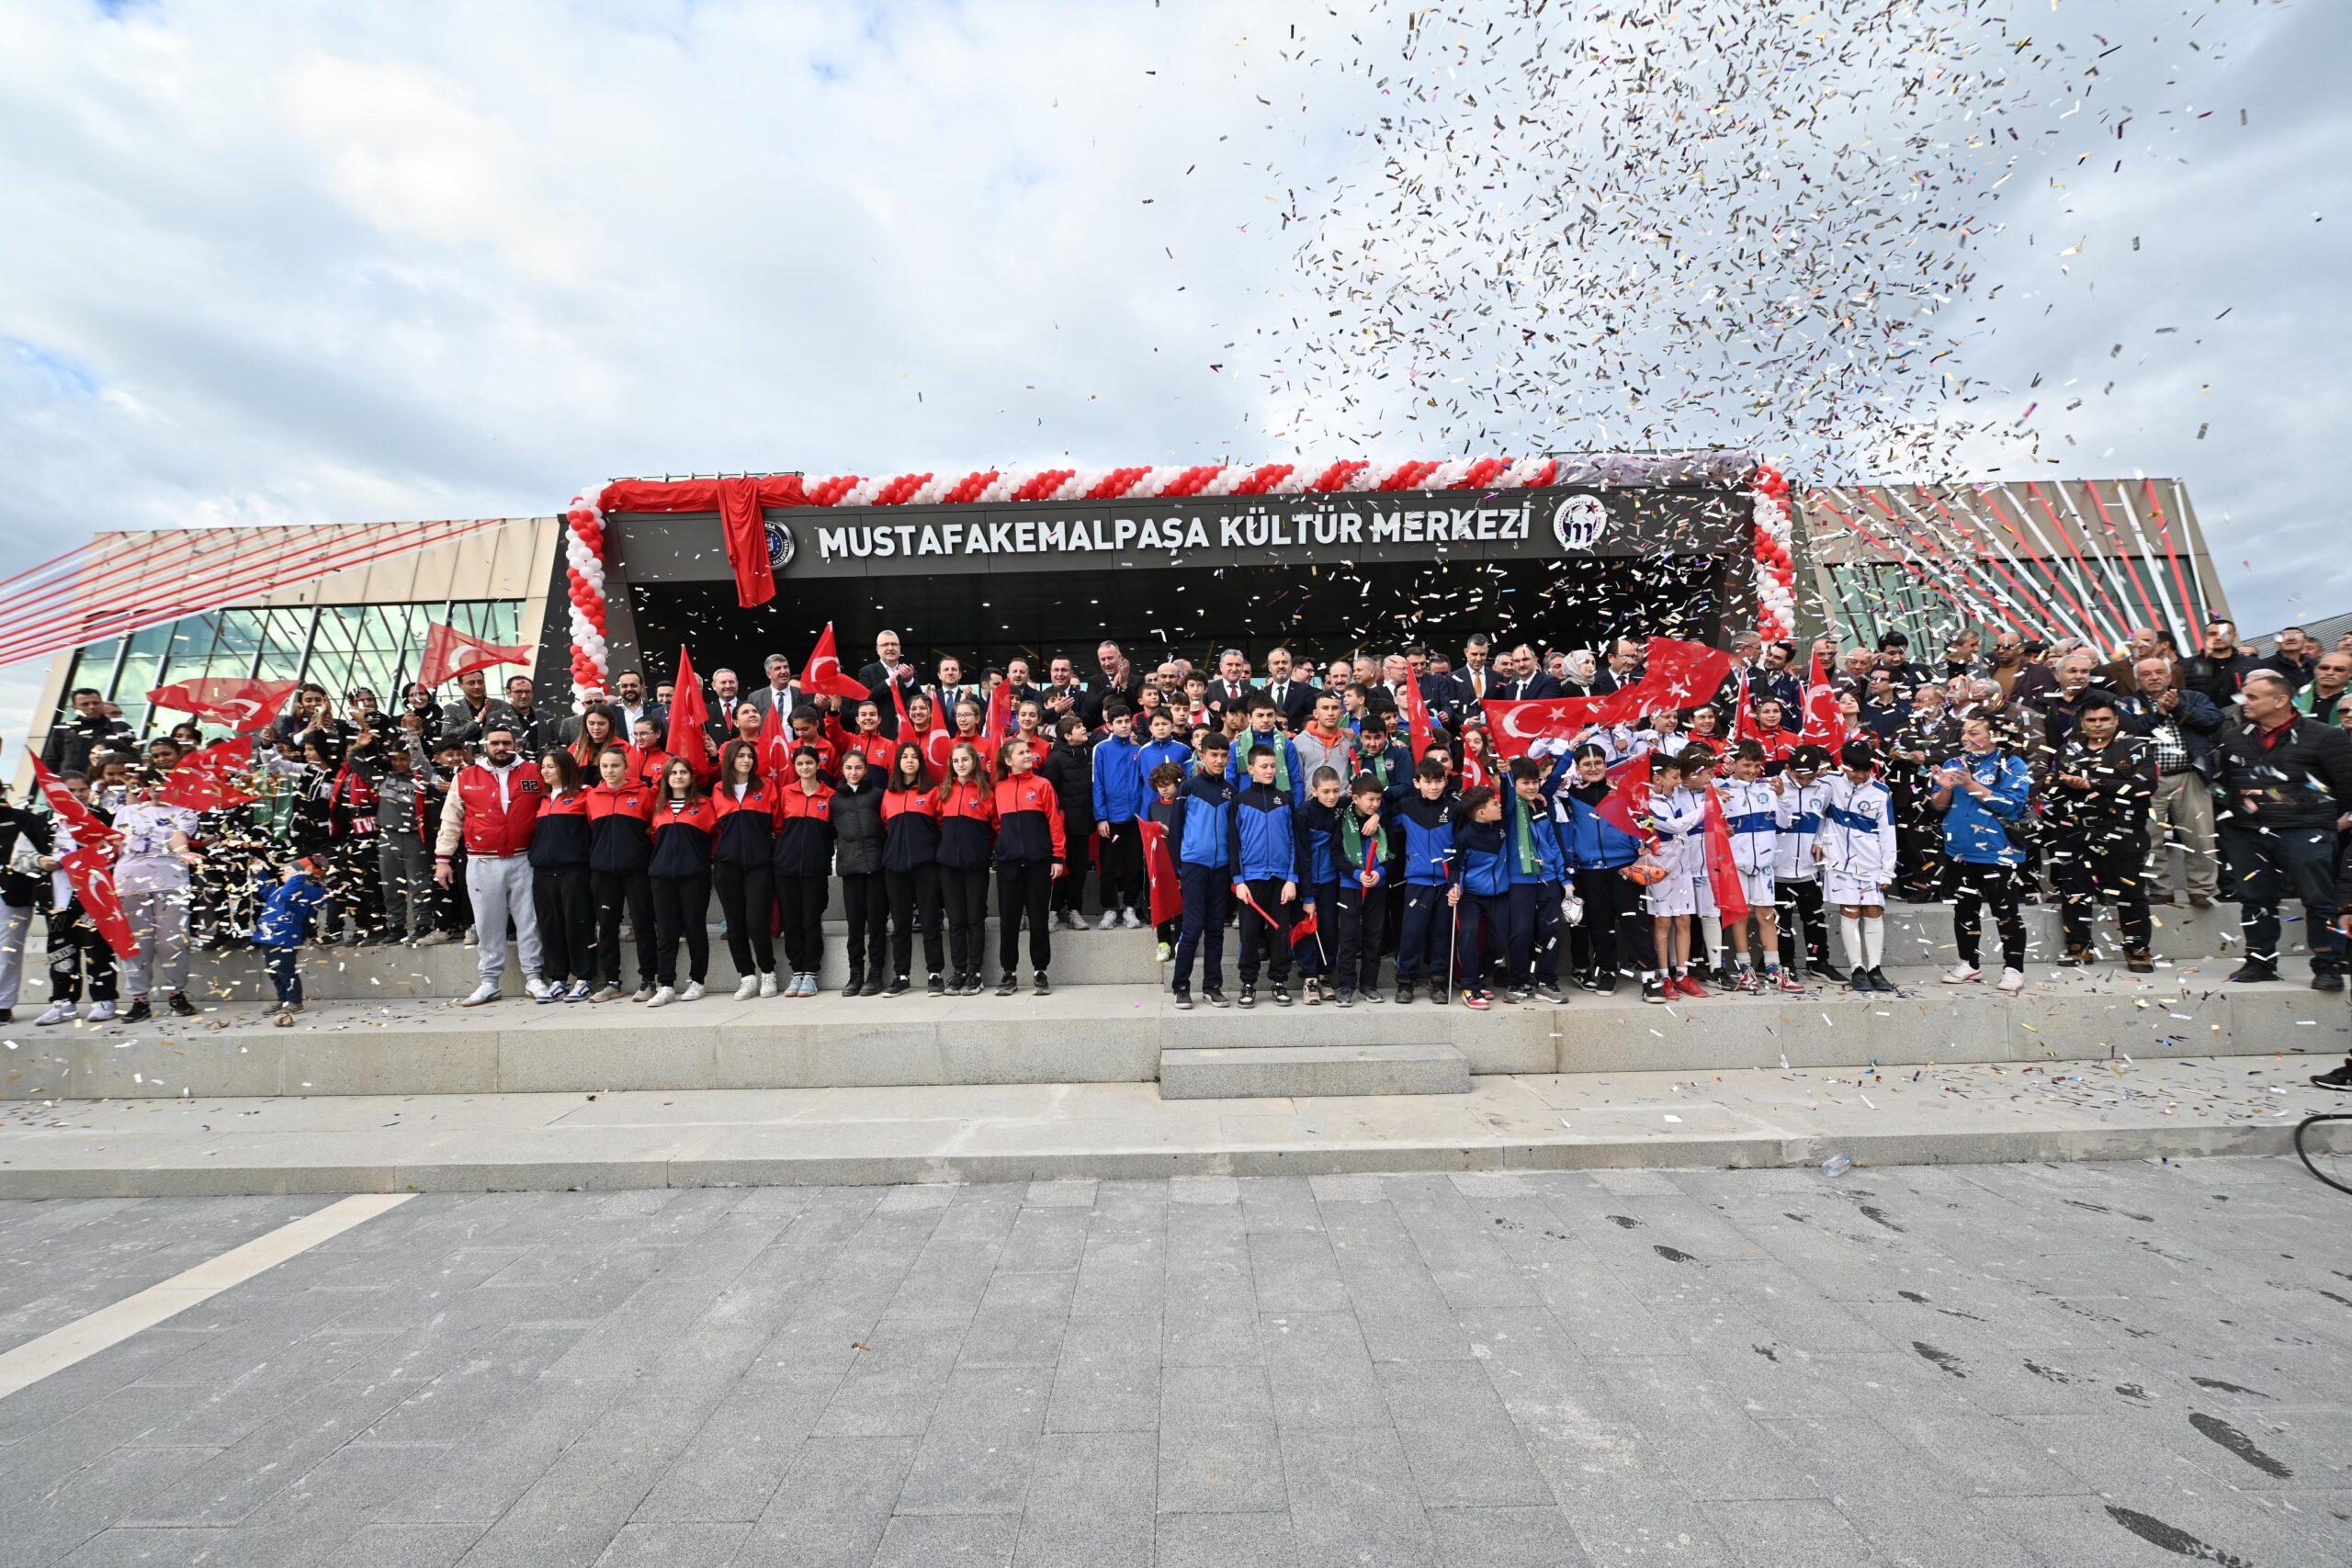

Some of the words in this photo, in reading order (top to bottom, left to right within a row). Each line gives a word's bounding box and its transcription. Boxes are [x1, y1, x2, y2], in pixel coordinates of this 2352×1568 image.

[818, 516, 1211, 558] MUSTAFAKEMALPAŞA
[1220, 504, 1363, 547] KÜLTÜR
[1372, 501, 1531, 544] MERKEZİ
[521, 779, 539, 793] 82
[1767, 878, 1773, 894] 4
